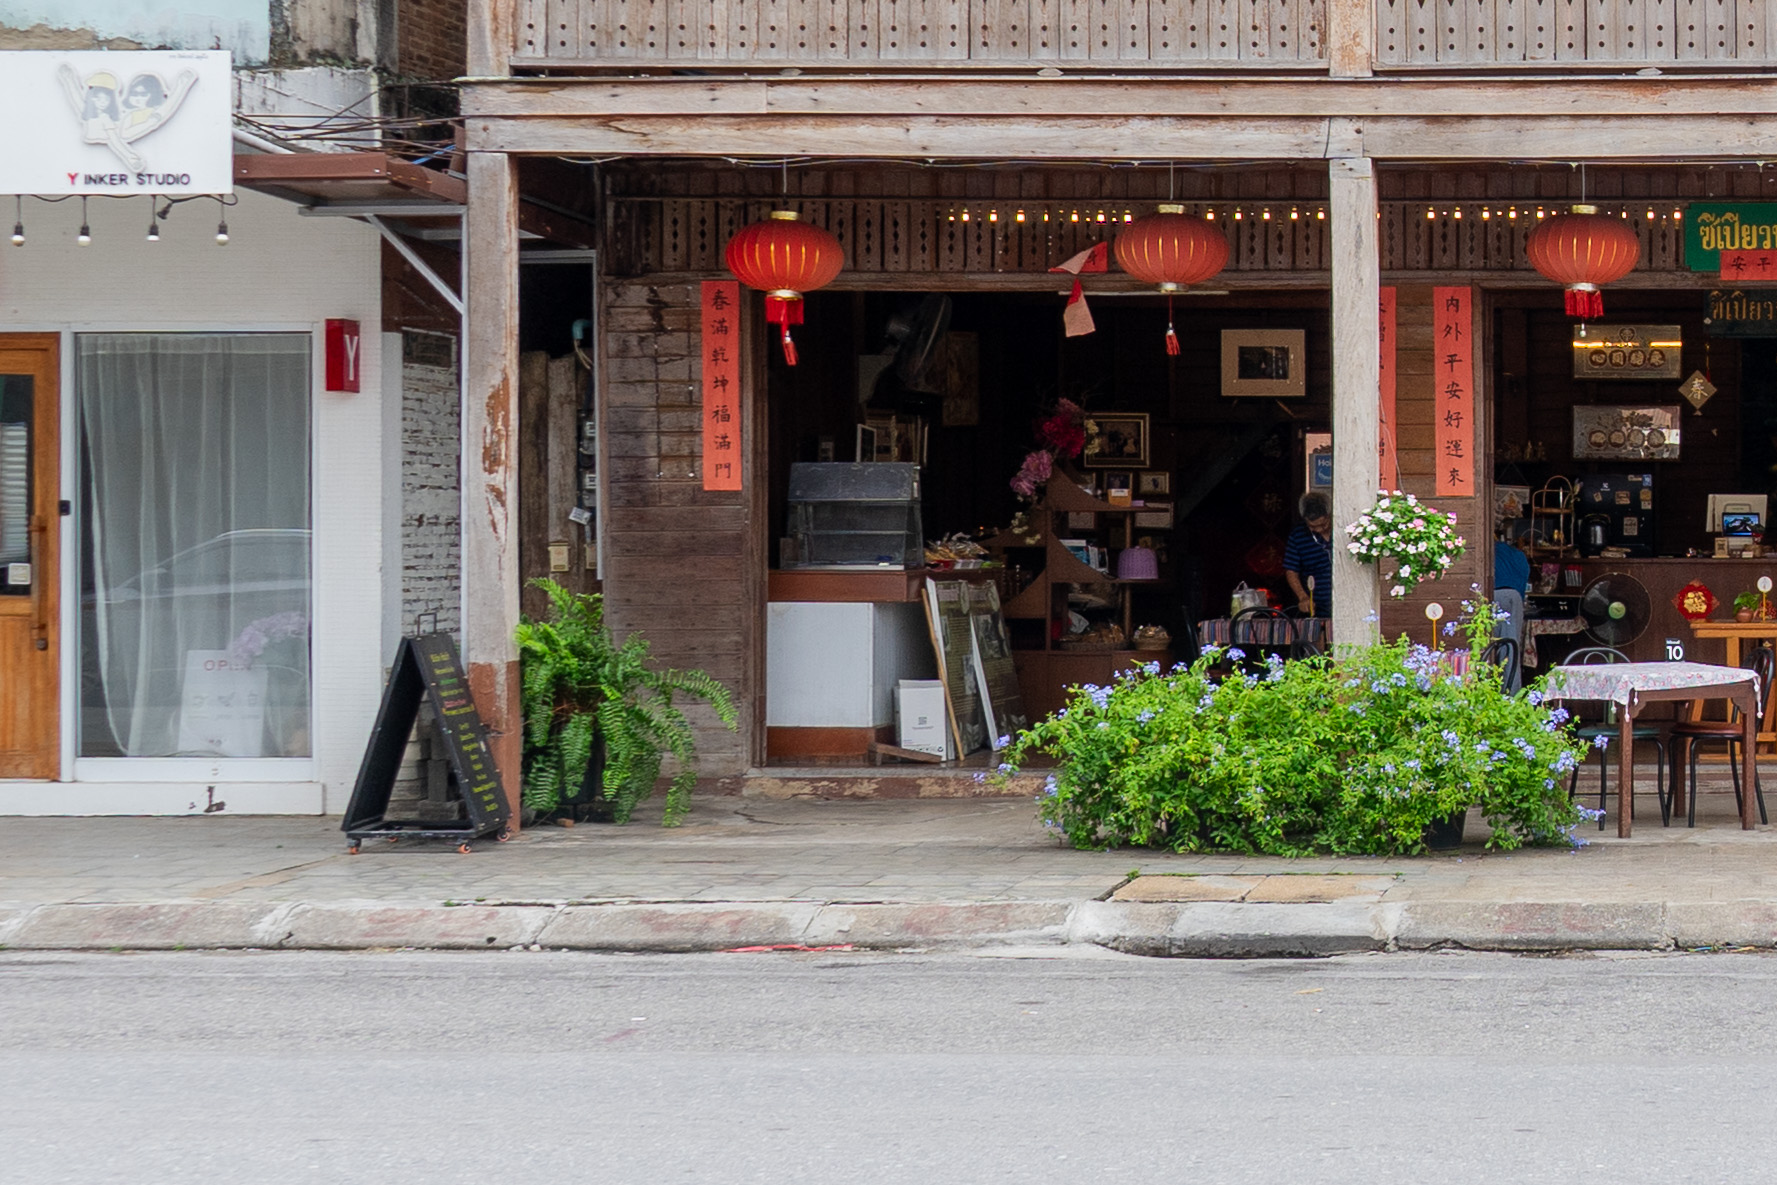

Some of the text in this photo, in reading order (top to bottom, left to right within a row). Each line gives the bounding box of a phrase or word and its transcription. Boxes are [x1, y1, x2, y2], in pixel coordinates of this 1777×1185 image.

[136, 173, 191, 186] STUDIO
[344, 334, 358, 382] Y
[1666, 645, 1684, 660] 10
